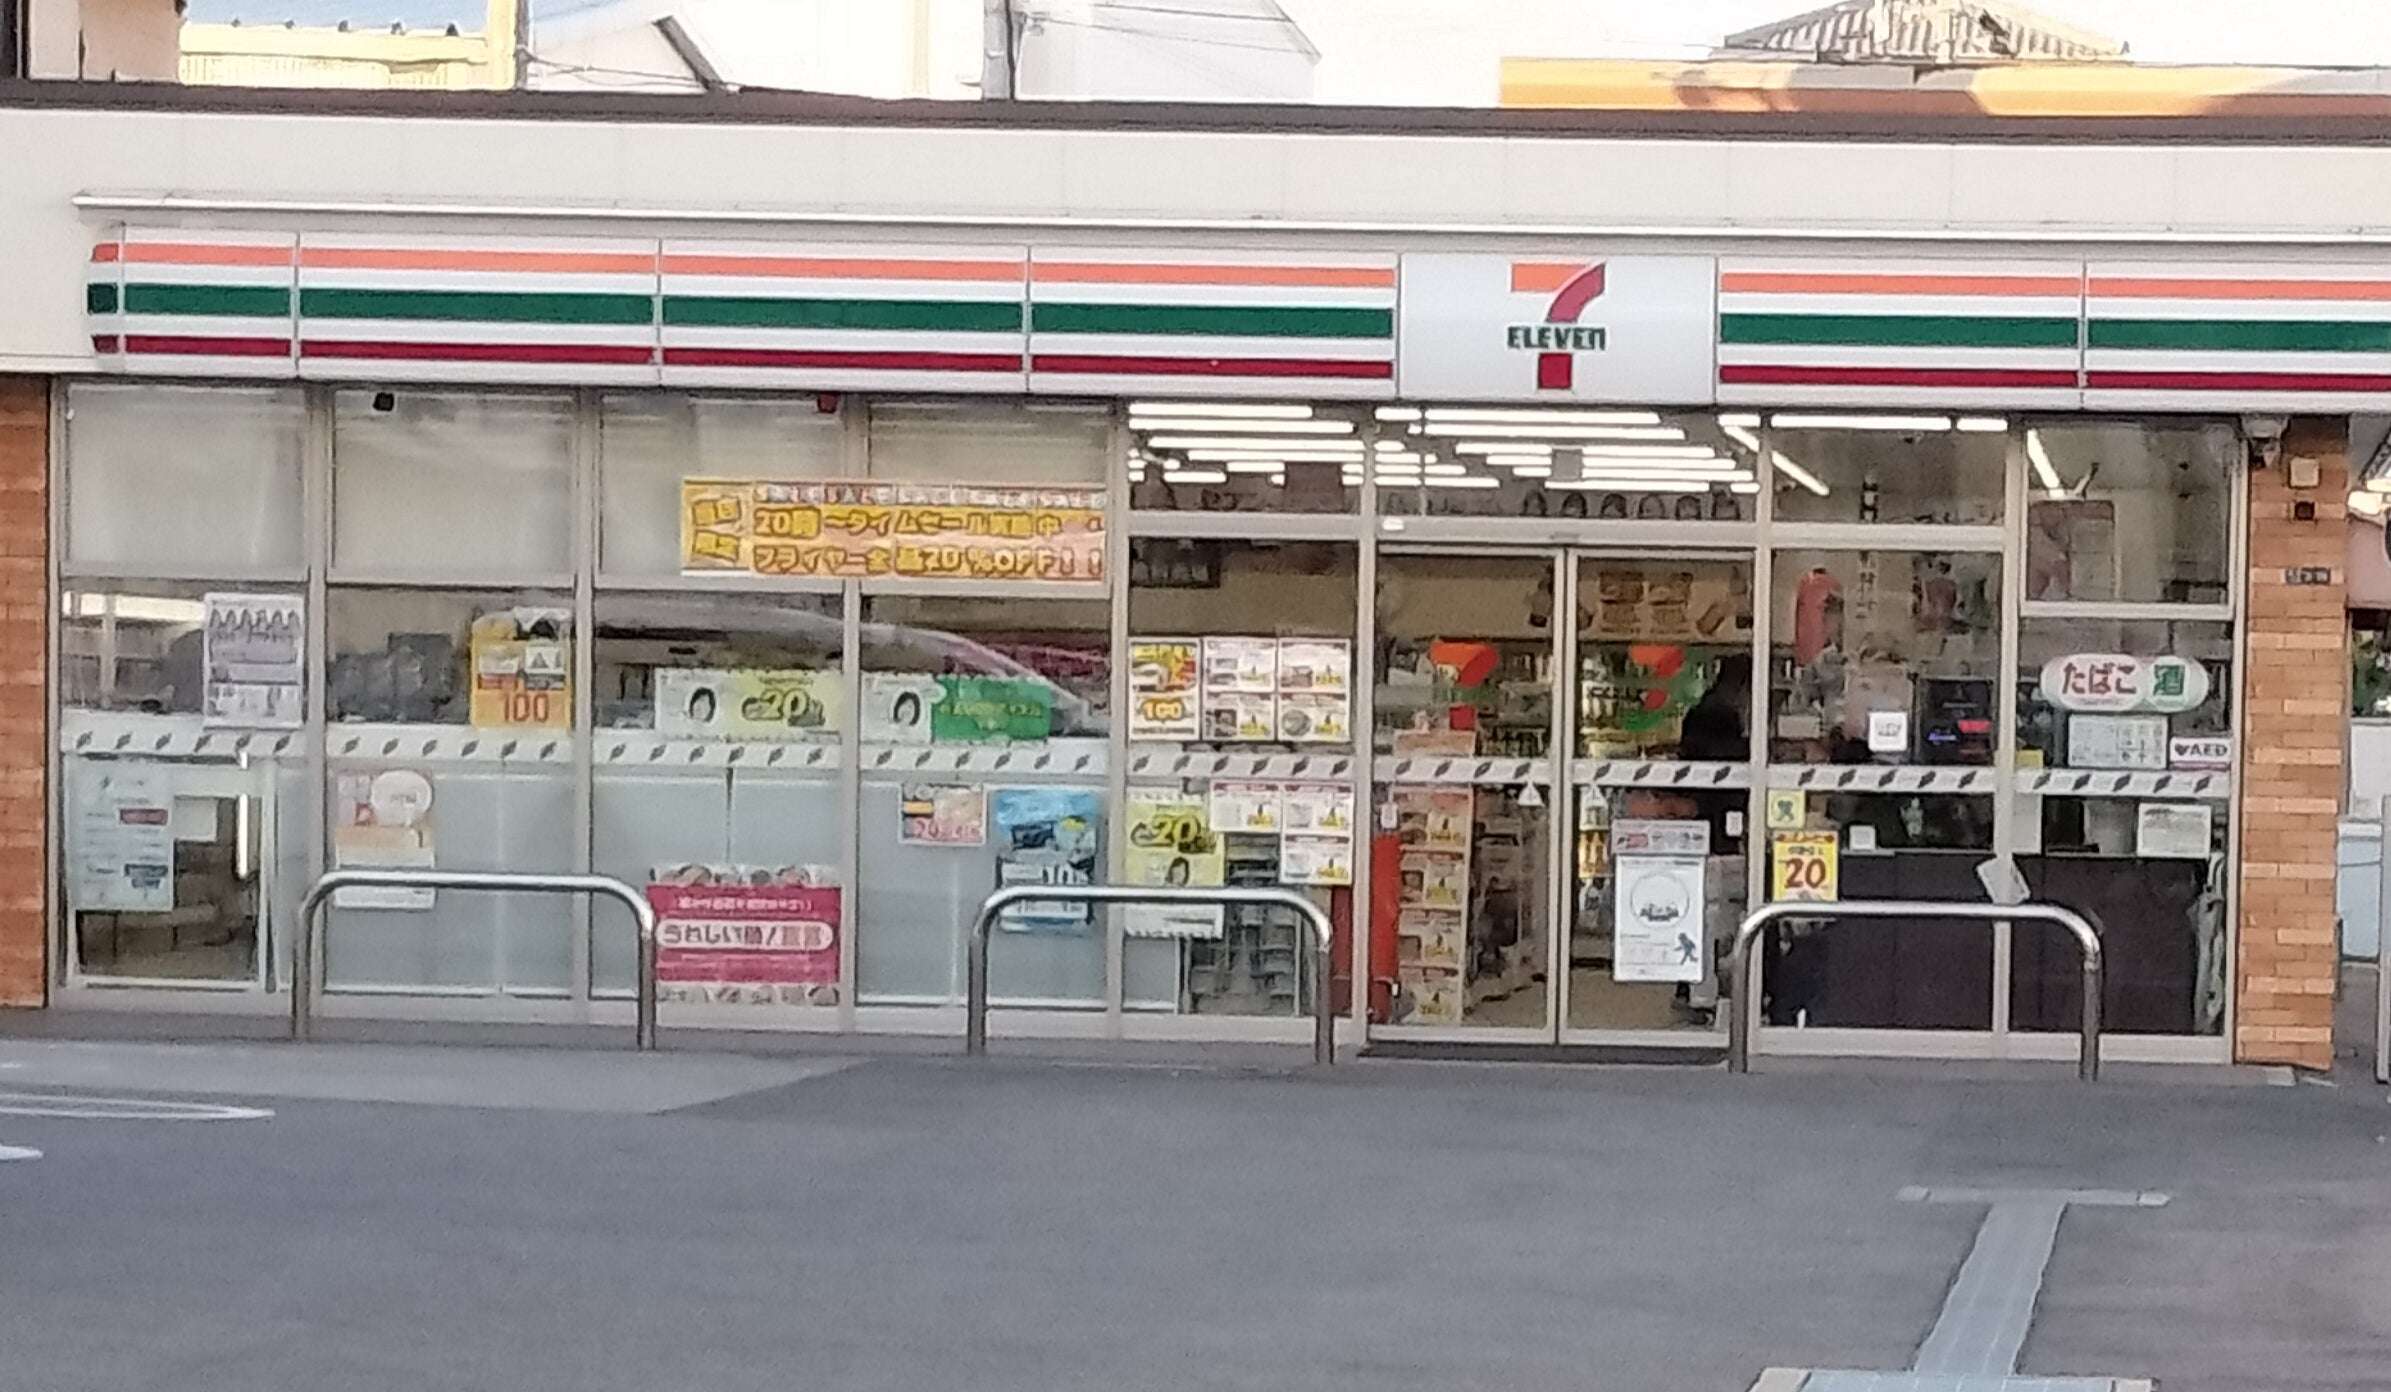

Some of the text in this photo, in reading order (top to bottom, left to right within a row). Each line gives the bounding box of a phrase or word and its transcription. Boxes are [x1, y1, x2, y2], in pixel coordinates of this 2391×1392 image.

[2062, 662, 2137, 695] たばこ
[504, 693, 549, 722] 100
[2189, 744, 2228, 757] AED
[1785, 857, 1826, 889] 20
